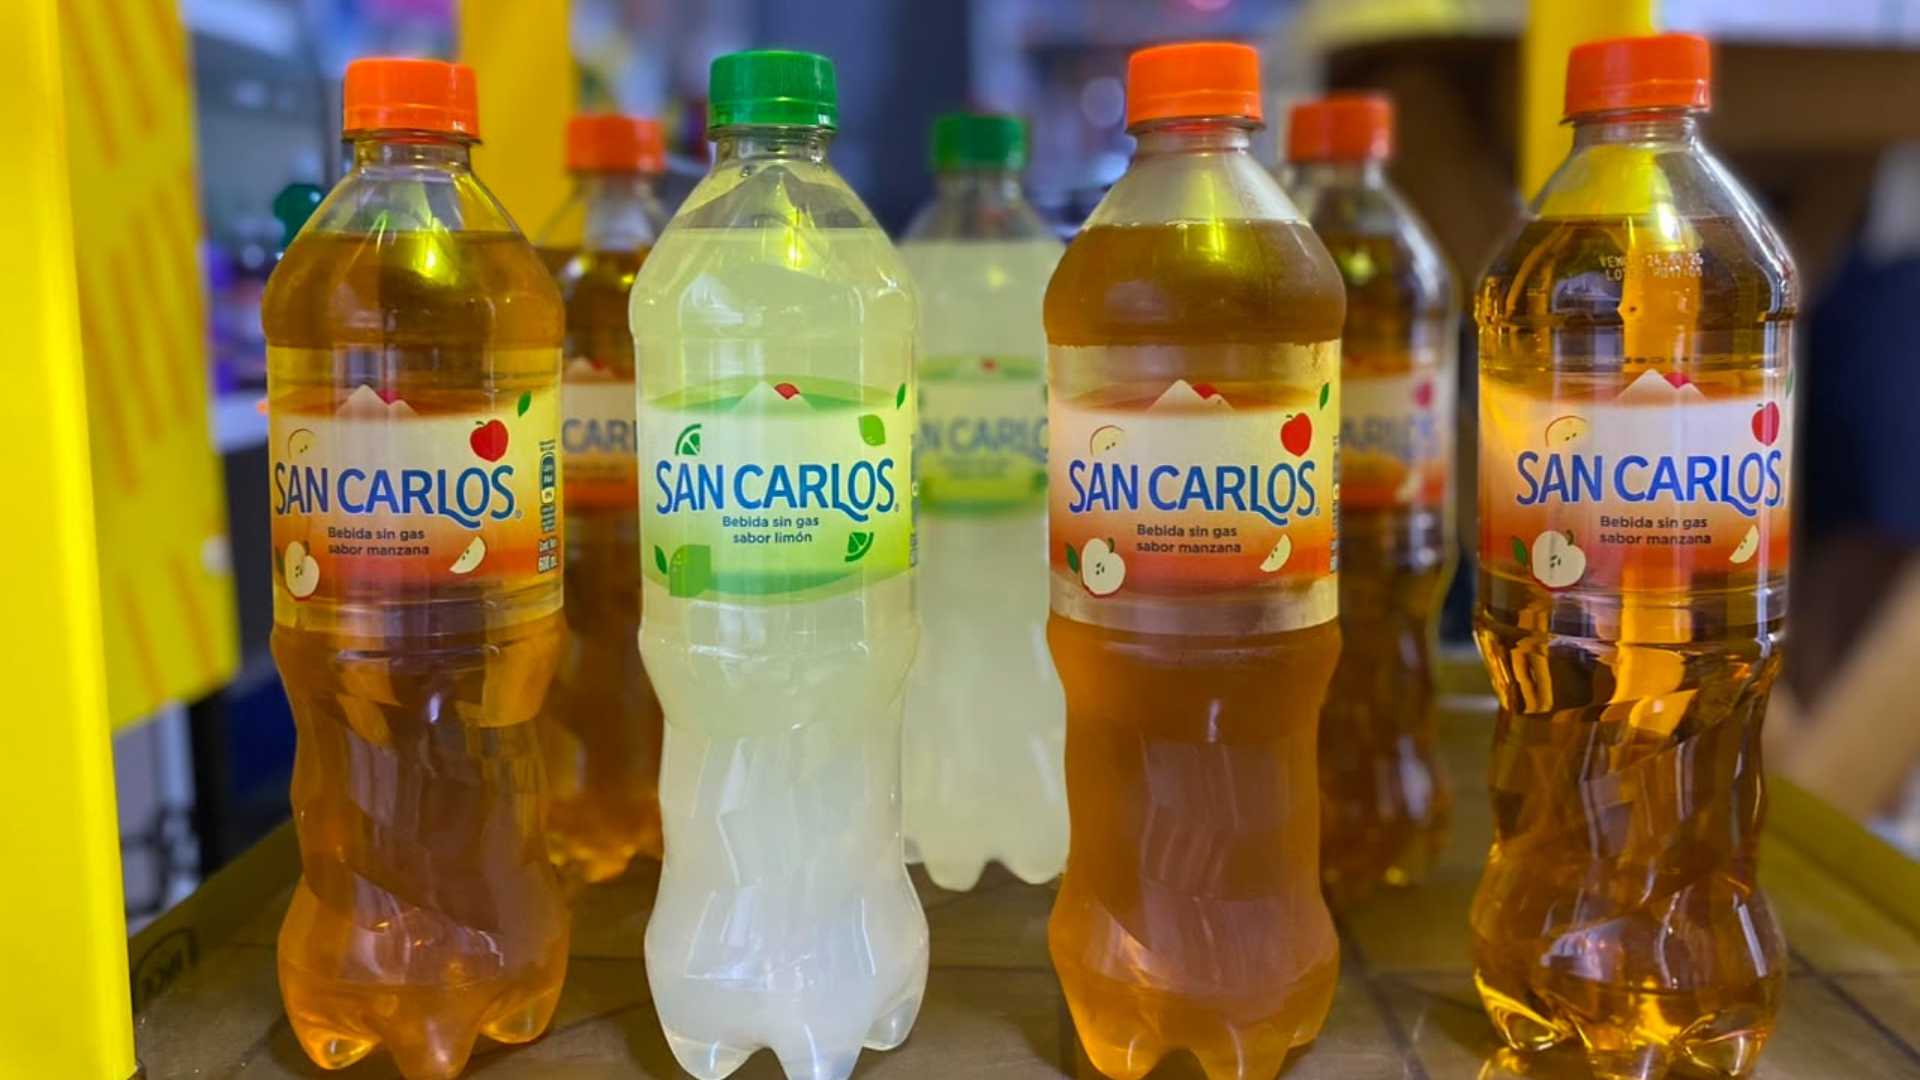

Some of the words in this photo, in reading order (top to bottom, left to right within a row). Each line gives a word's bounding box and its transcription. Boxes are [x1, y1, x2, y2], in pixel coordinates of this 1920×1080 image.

[656, 460, 724, 514] SAN
[733, 458, 895, 522] CARLOS
[1516, 451, 1603, 505] SAN
[1613, 450, 1782, 517] CARLOS
[274, 462, 328, 515] SAN
[337, 465, 515, 528] CARLOS
[1069, 459, 1138, 513] SAN
[1148, 460, 1316, 526] CARLOS
[723, 515, 769, 528] Bebida
[772, 516, 792, 527] sin
[796, 517, 819, 529] gas
[1600, 515, 1653, 528] Bebida
[1656, 517, 1678, 528] sin
[1683, 518, 1708, 530] gas
[328, 526, 372, 539] Bebida
[376, 528, 395, 539] sin
[400, 530, 425, 541] gas
[733, 532, 771, 544] sabor
[775, 531, 813, 543] limón
[1137, 524, 1185, 537] Bebida
[1189, 525, 1209, 537] sin
[1213, 527, 1237, 539] gas
[1600, 533, 1642, 544] sabor
[1647, 534, 1712, 545] manzana
[328, 543, 362, 554] sabor
[367, 546, 429, 555] manzana
[1136, 541, 1174, 552] sabor
[1179, 543, 1242, 553] manzana
